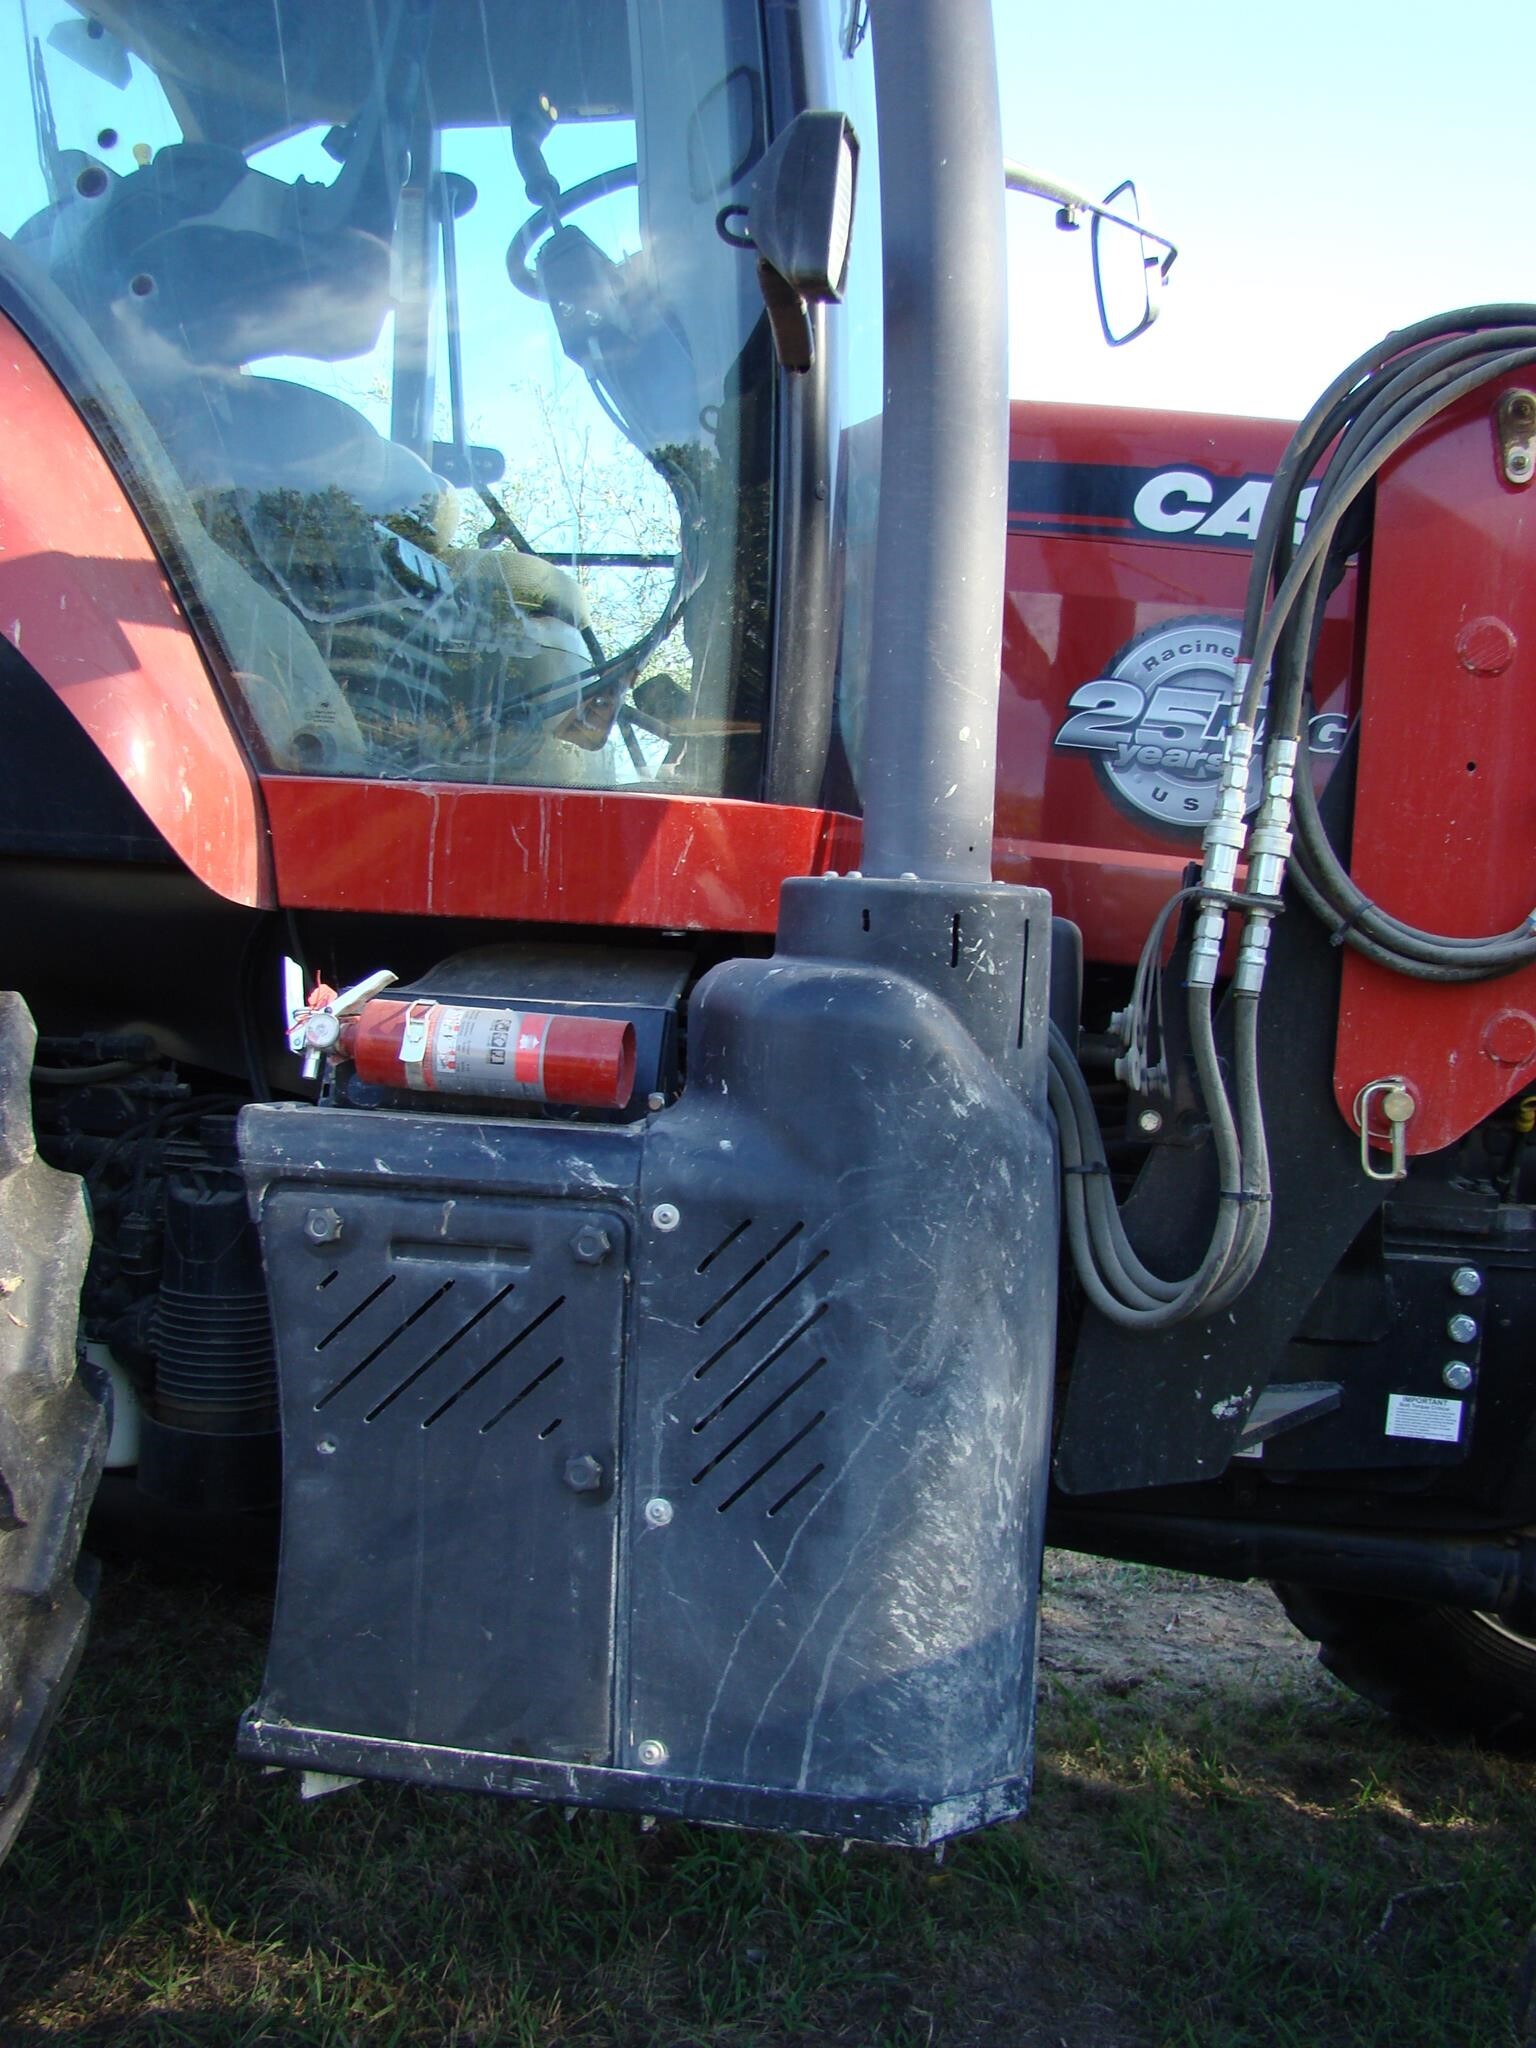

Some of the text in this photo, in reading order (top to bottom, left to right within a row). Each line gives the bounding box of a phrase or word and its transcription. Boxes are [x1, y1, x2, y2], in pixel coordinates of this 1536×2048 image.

[1142, 639, 1236, 673] Racine
[1054, 678, 1224, 751] 25
[1112, 742, 1225, 772] years
[1402, 1395, 1448, 1406] IMPORTANT
